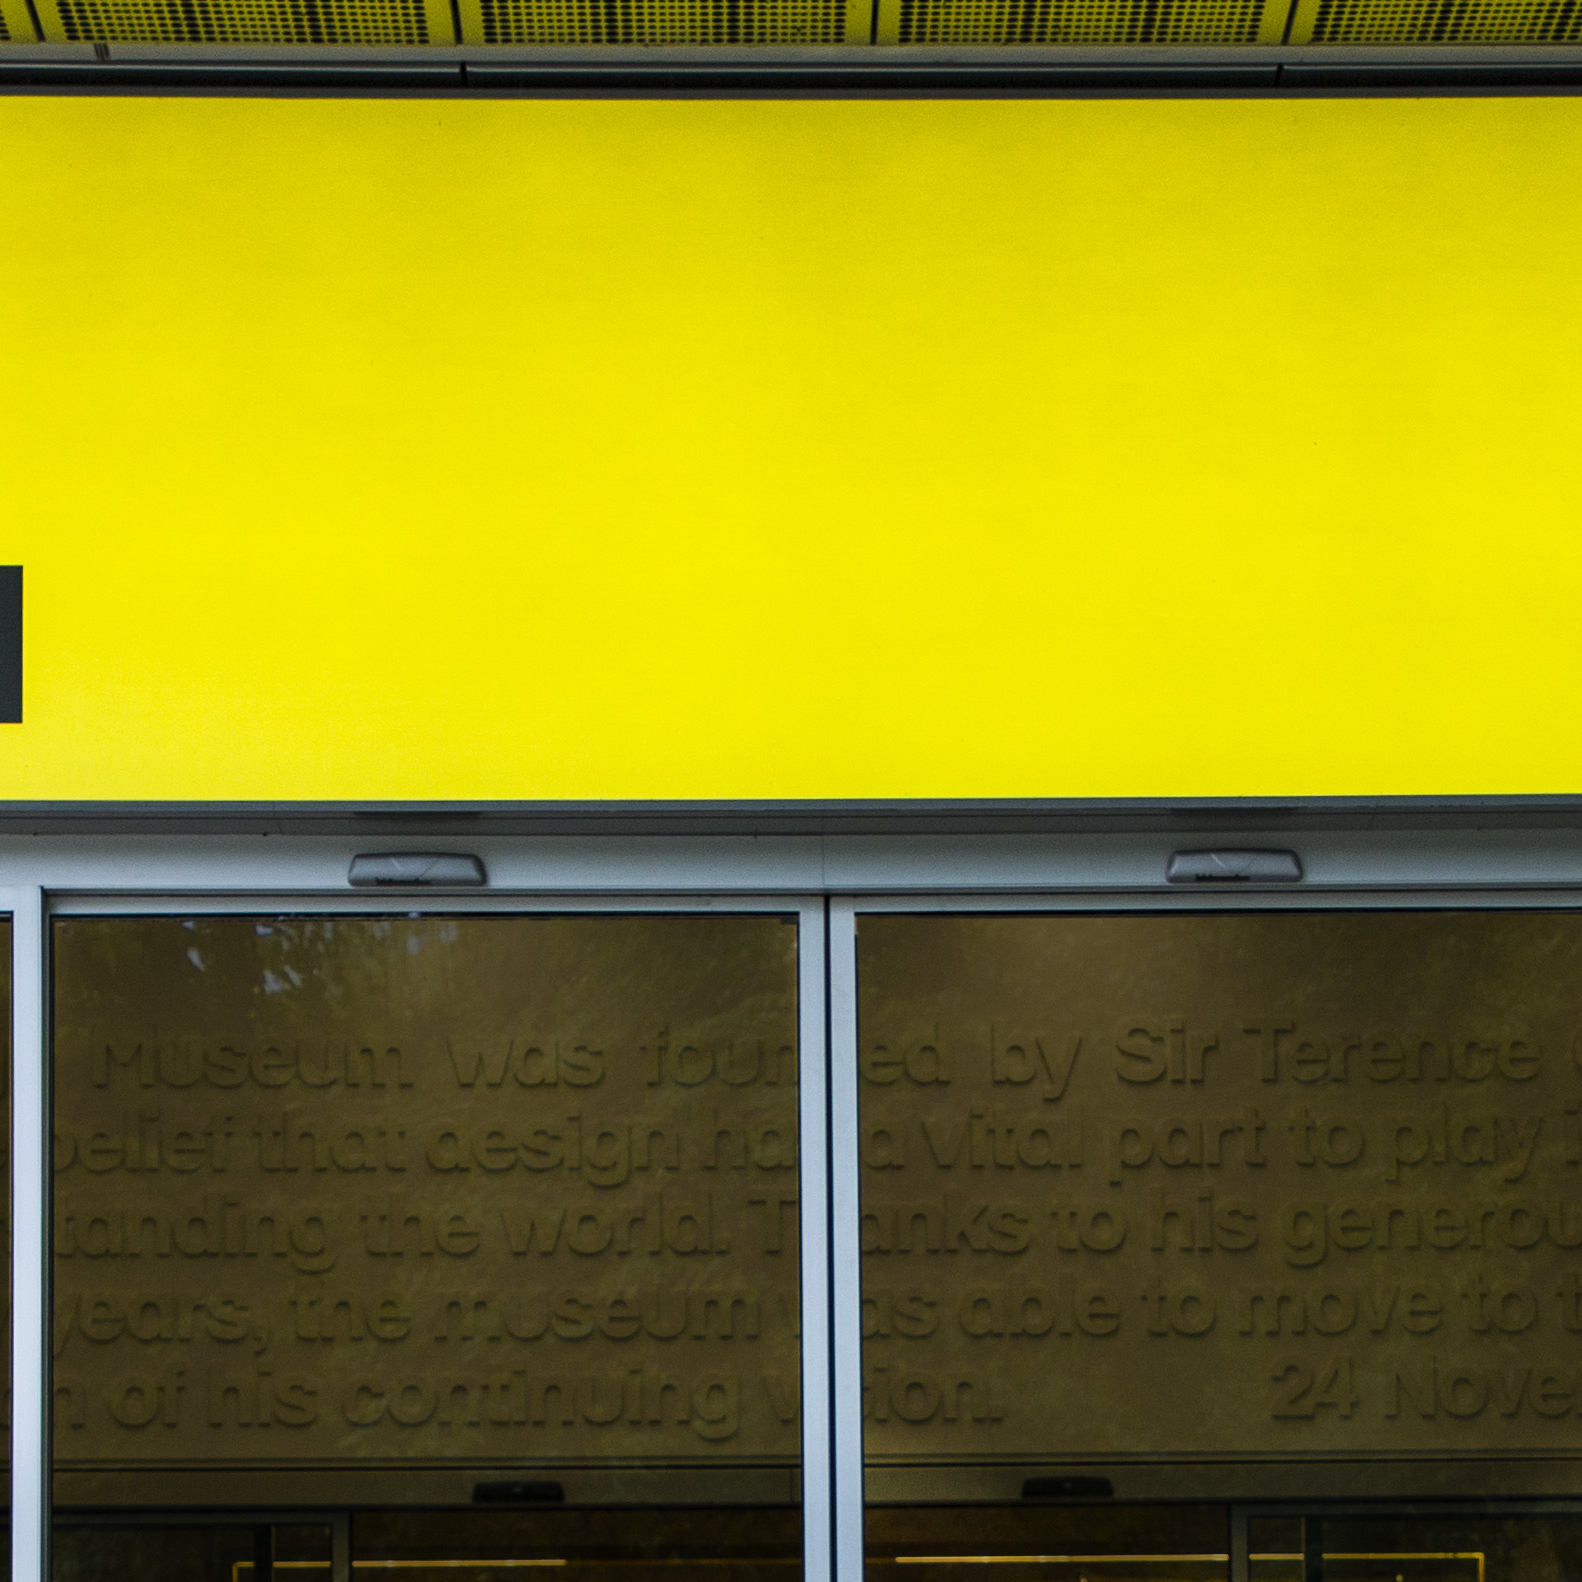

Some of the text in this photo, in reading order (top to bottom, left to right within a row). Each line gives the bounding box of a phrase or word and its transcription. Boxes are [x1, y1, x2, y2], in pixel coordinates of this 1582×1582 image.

[90, 1026, 416, 1090] Museum
[445, 1034, 608, 1088] was
[638, 1020, 951, 1089] founed
[989, 1018, 1086, 1103] by
[1113, 1014, 1219, 1086] Sir
[1240, 1018, 1543, 1085] Terence
[249, 1106, 407, 1173] that
[424, 1106, 680, 1188] design
[701, 1106, 799, 1173] ha
[919, 1104, 1085, 1172] vital
[1106, 1106, 1267, 1187] part
[1286, 1108, 1365, 1169] to
[1383, 1098, 1545, 1184] play
[358, 1194, 481, 1258] the
[502, 1193, 731, 1258] world.
[745, 1192, 1032, 1256] Tanks
[1050, 1196, 1129, 1254] to
[1150, 1188, 1259, 1254] his
[287, 1278, 413, 1343] the
[432, 1289, 763, 1343] museum
[957, 1273, 1123, 1339] able
[1138, 1278, 1218, 1338] to
[1237, 1290, 1444, 1338] move
[1458, 1277, 1538, 1337] to
[108, 1366, 188, 1430] of
[207, 1364, 320, 1430] his
[342, 1366, 743, 1441] continuing
[1268, 1355, 1358, 1421] 24
